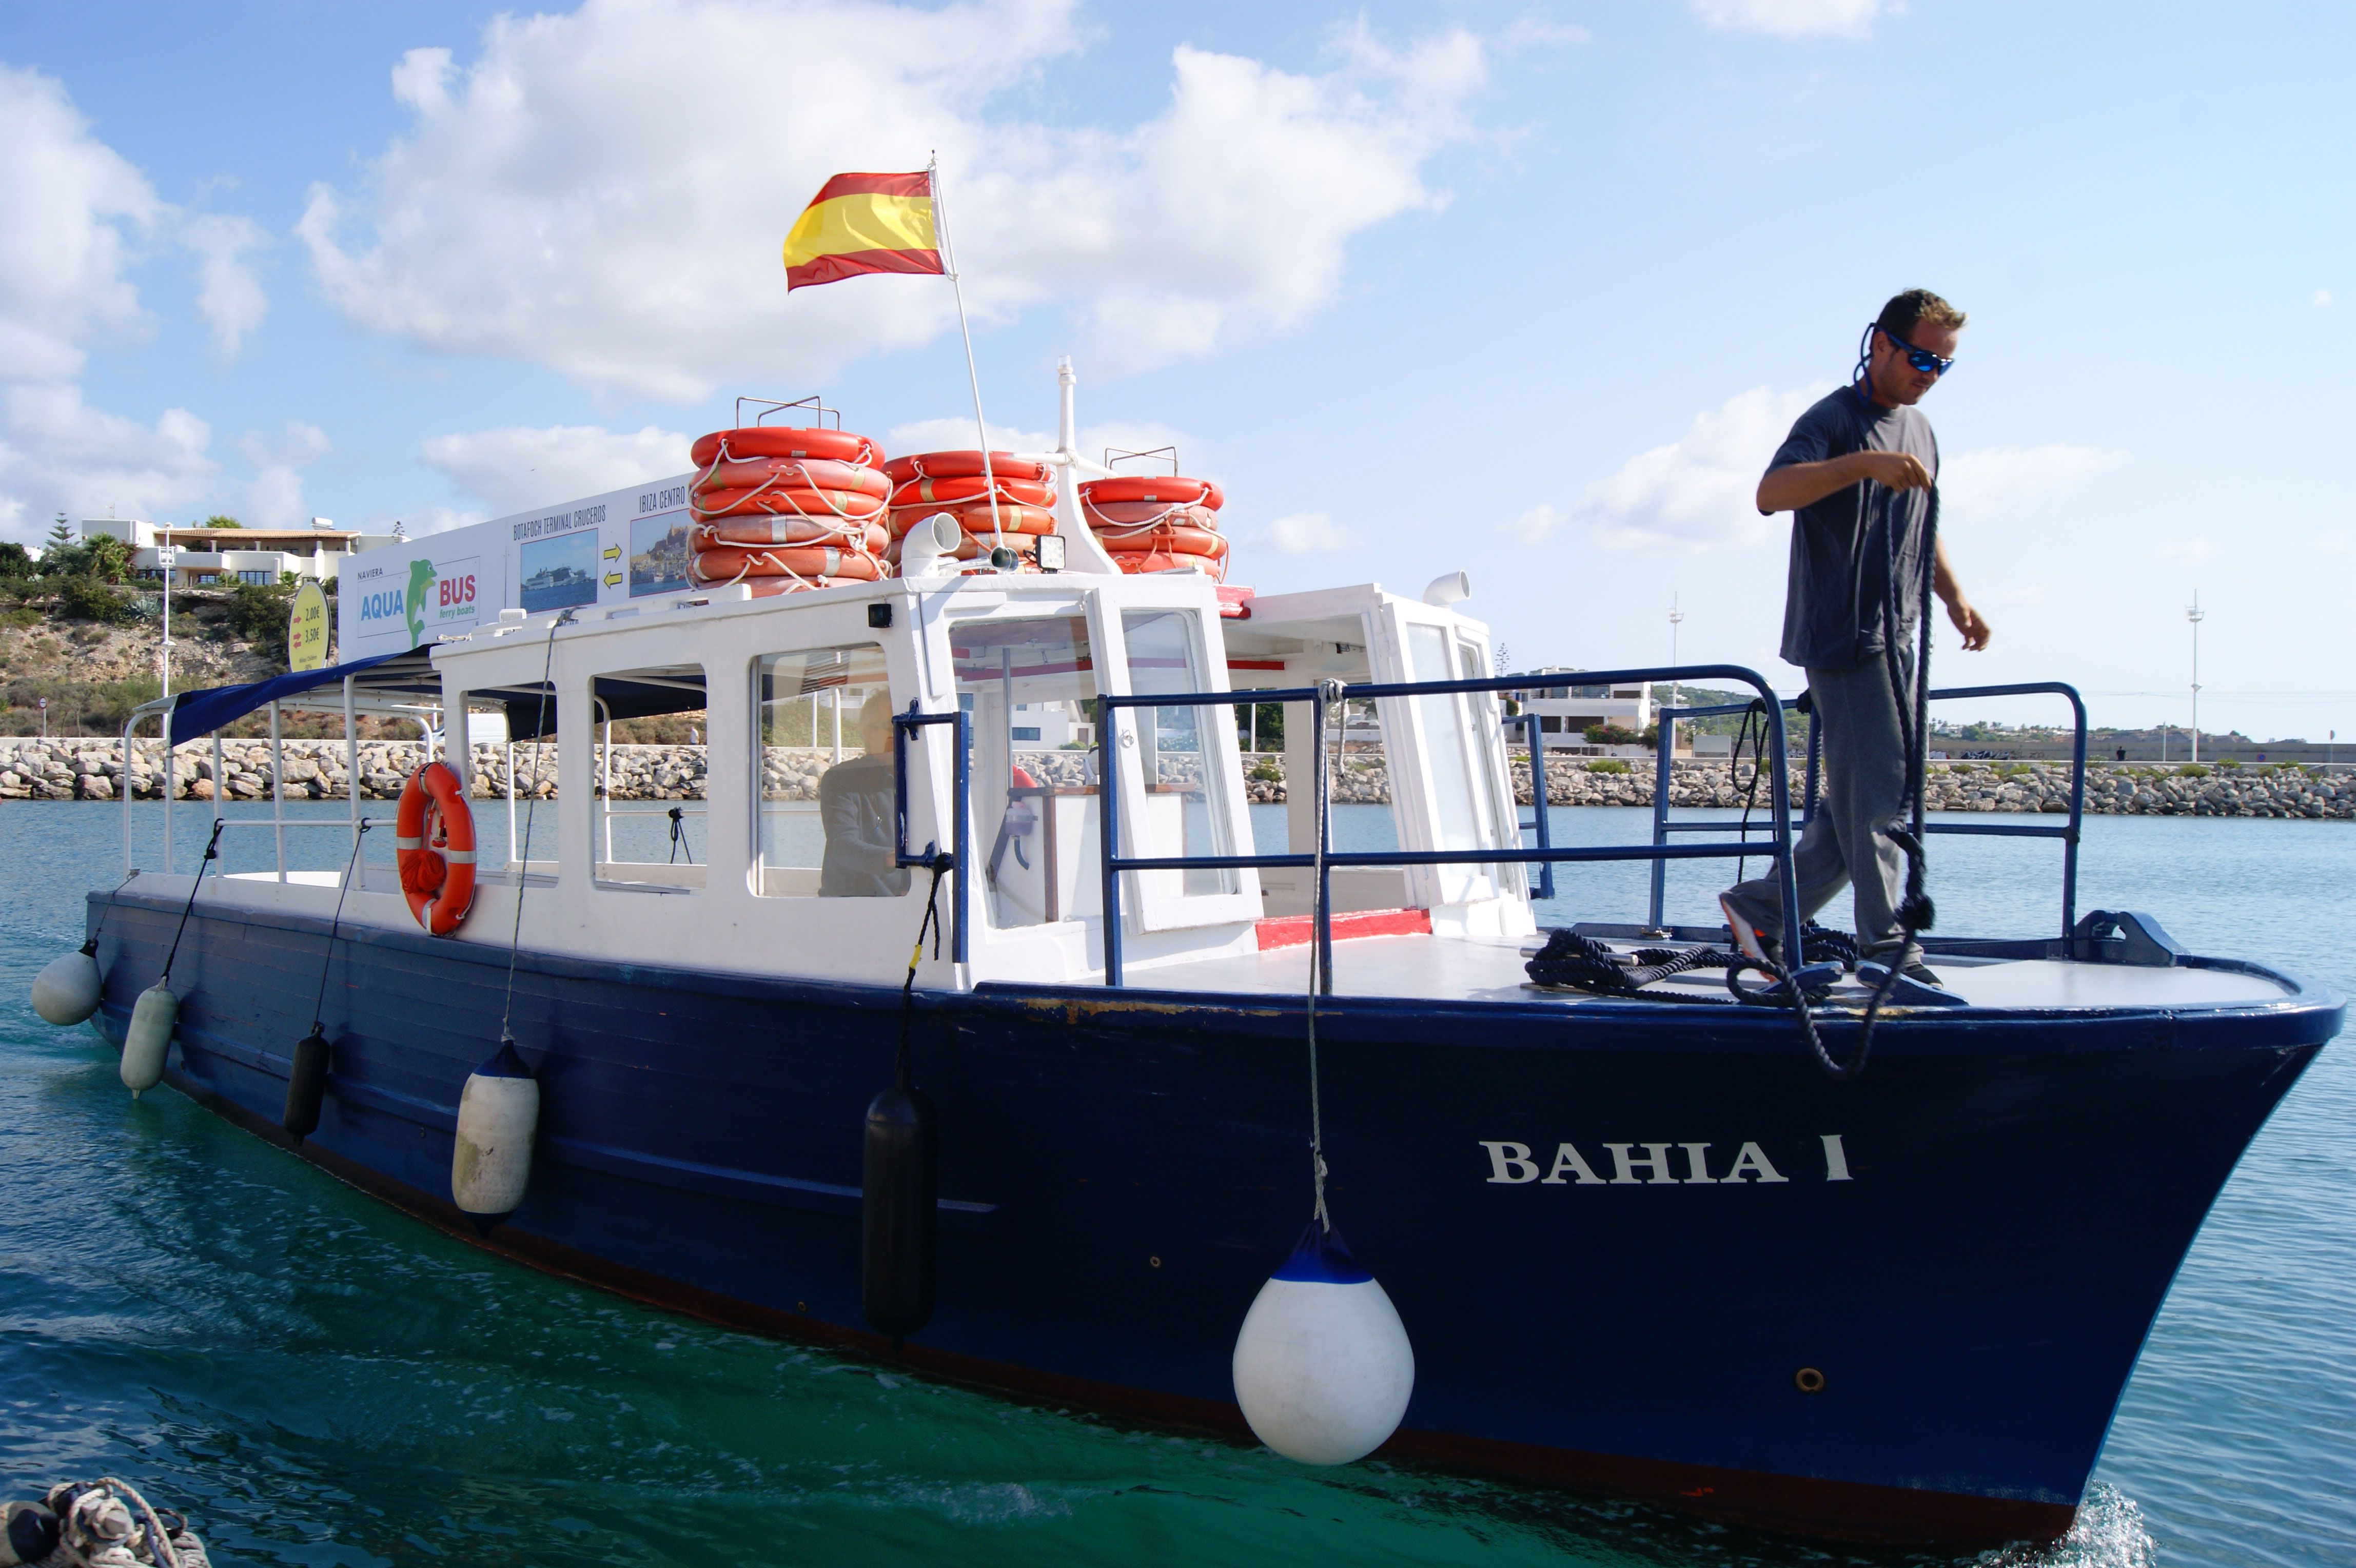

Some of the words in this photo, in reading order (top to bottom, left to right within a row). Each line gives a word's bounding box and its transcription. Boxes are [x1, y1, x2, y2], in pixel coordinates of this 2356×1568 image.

[639, 493, 657, 513] IBIZA
[659, 486, 685, 509] CENTRO
[514, 519, 542, 540] BOTAFOCH
[544, 513, 572, 535] TERMINAL
[574, 504, 606, 527] CRUCEROS
[358, 567, 383, 580] NAVIERA
[361, 590, 404, 621] AQUA
[440, 575, 476, 606] BUS
[306, 605, 320, 622] 2,00€
[440, 609, 455, 619] ferry
[457, 605, 475, 616] boats
[305, 627, 320, 644] 3,50€
[1479, 1140, 1790, 1184] BAHIA
[1819, 1134, 1854, 1181] I
